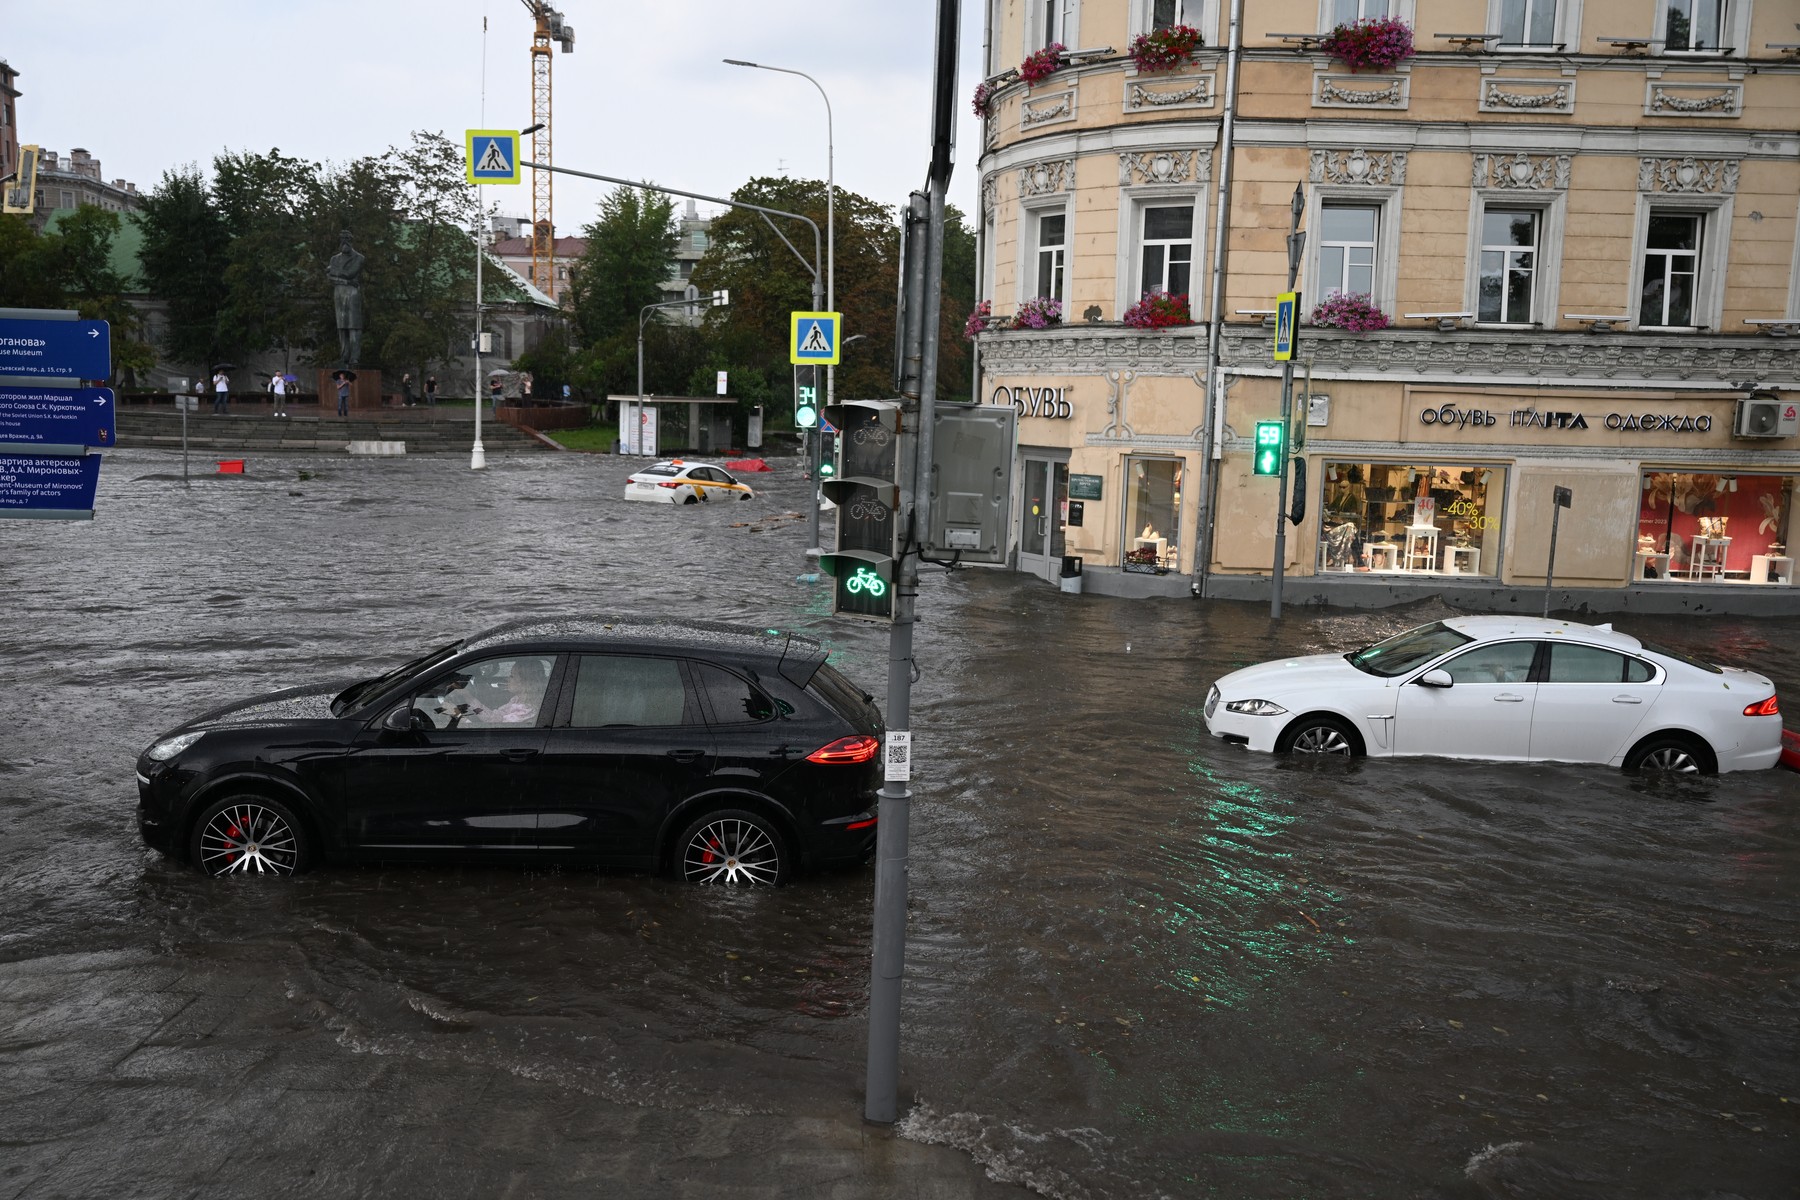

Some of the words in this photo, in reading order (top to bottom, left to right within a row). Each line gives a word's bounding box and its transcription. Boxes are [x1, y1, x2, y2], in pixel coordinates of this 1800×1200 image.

[0, 393, 27, 401] отором
[43, 394, 73, 402] Маршал
[799, 386, 816, 405] 34
[13, 402, 36, 410] Союза
[49, 404, 86, 412] Куркоткин
[993, 386, 1073, 419] ОБУВЬ
[1420, 403, 1496, 430] обувь
[1604, 412, 1712, 433] одежда
[1259, 426, 1280, 445] 59
[0, 458, 34, 467] артира
[35, 459, 80, 467] актерской
[26, 467, 83, 476] Мироновых-
[52, 482, 83, 490] Mironovs'
[10, 489, 31, 497] family
[1442, 501, 1479, 516] -40%
[1464, 516, 1499, 530] -30%
